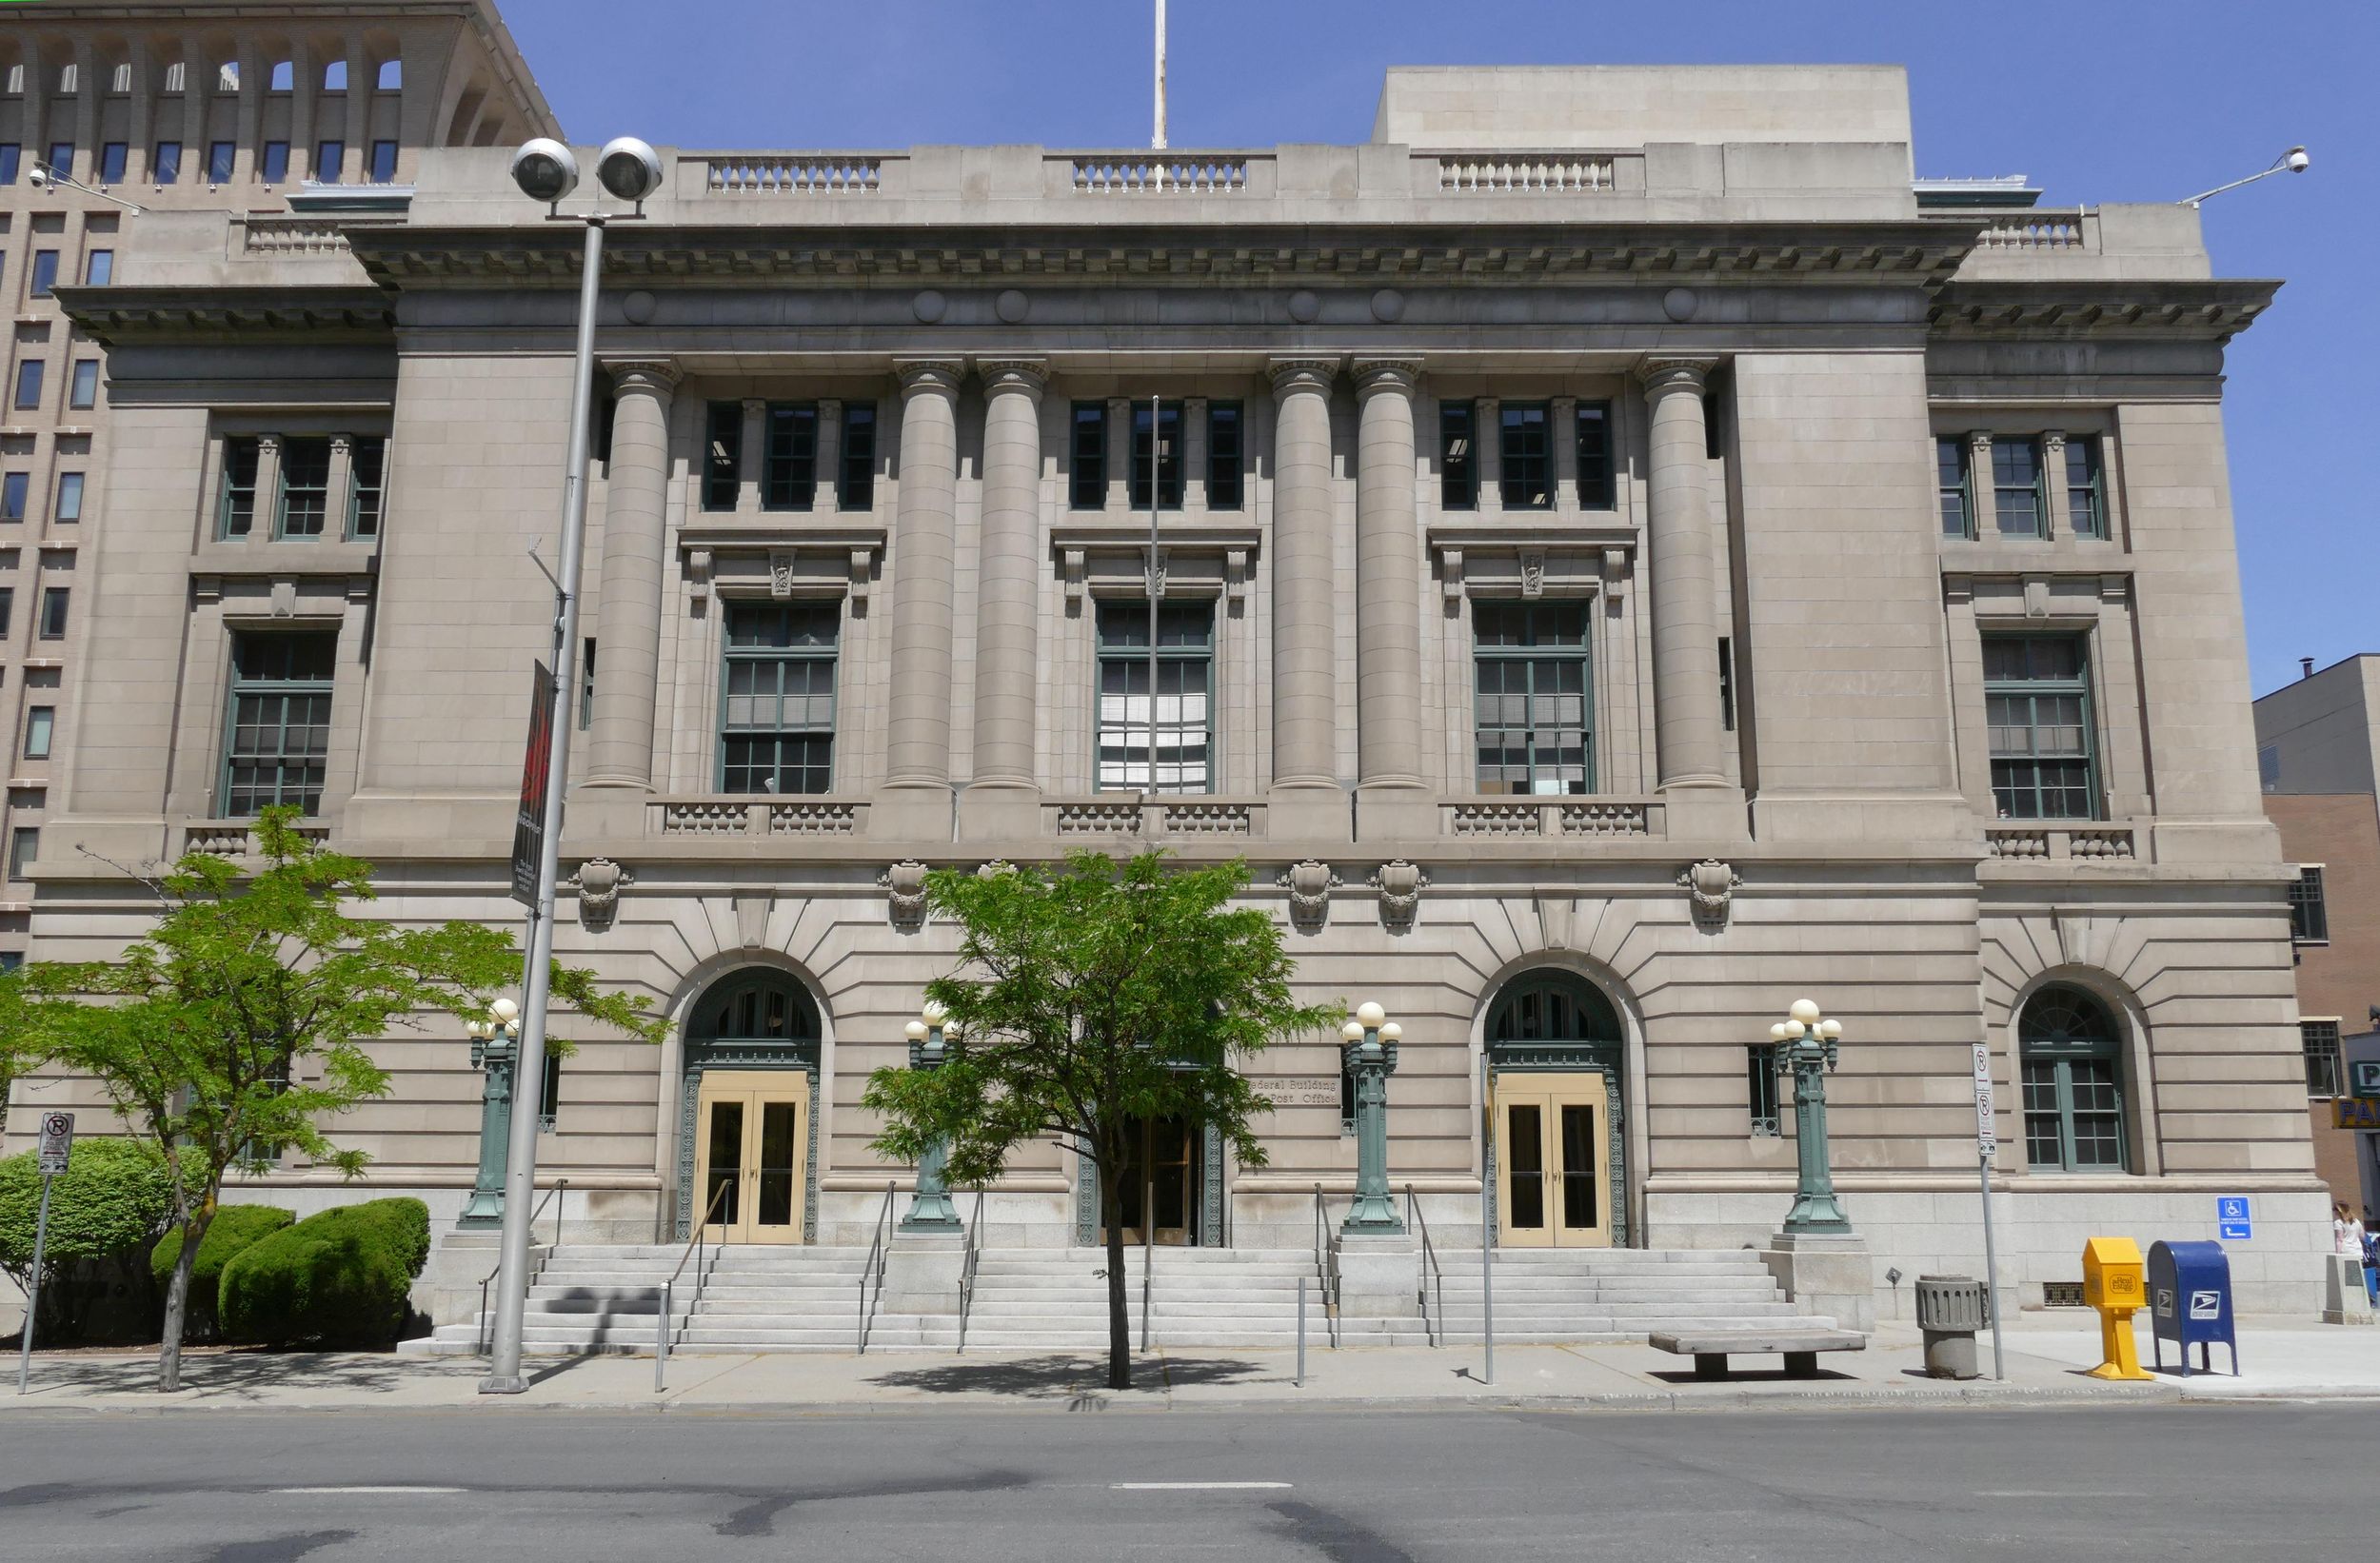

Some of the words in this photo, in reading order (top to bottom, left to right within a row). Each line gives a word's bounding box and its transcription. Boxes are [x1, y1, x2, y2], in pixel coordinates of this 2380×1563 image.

[1249, 1079, 1285, 1090] ederal
[1289, 1079, 1336, 1092] Building
[1271, 1094, 1294, 1103] Post
[1302, 1094, 1337, 1103] Office
